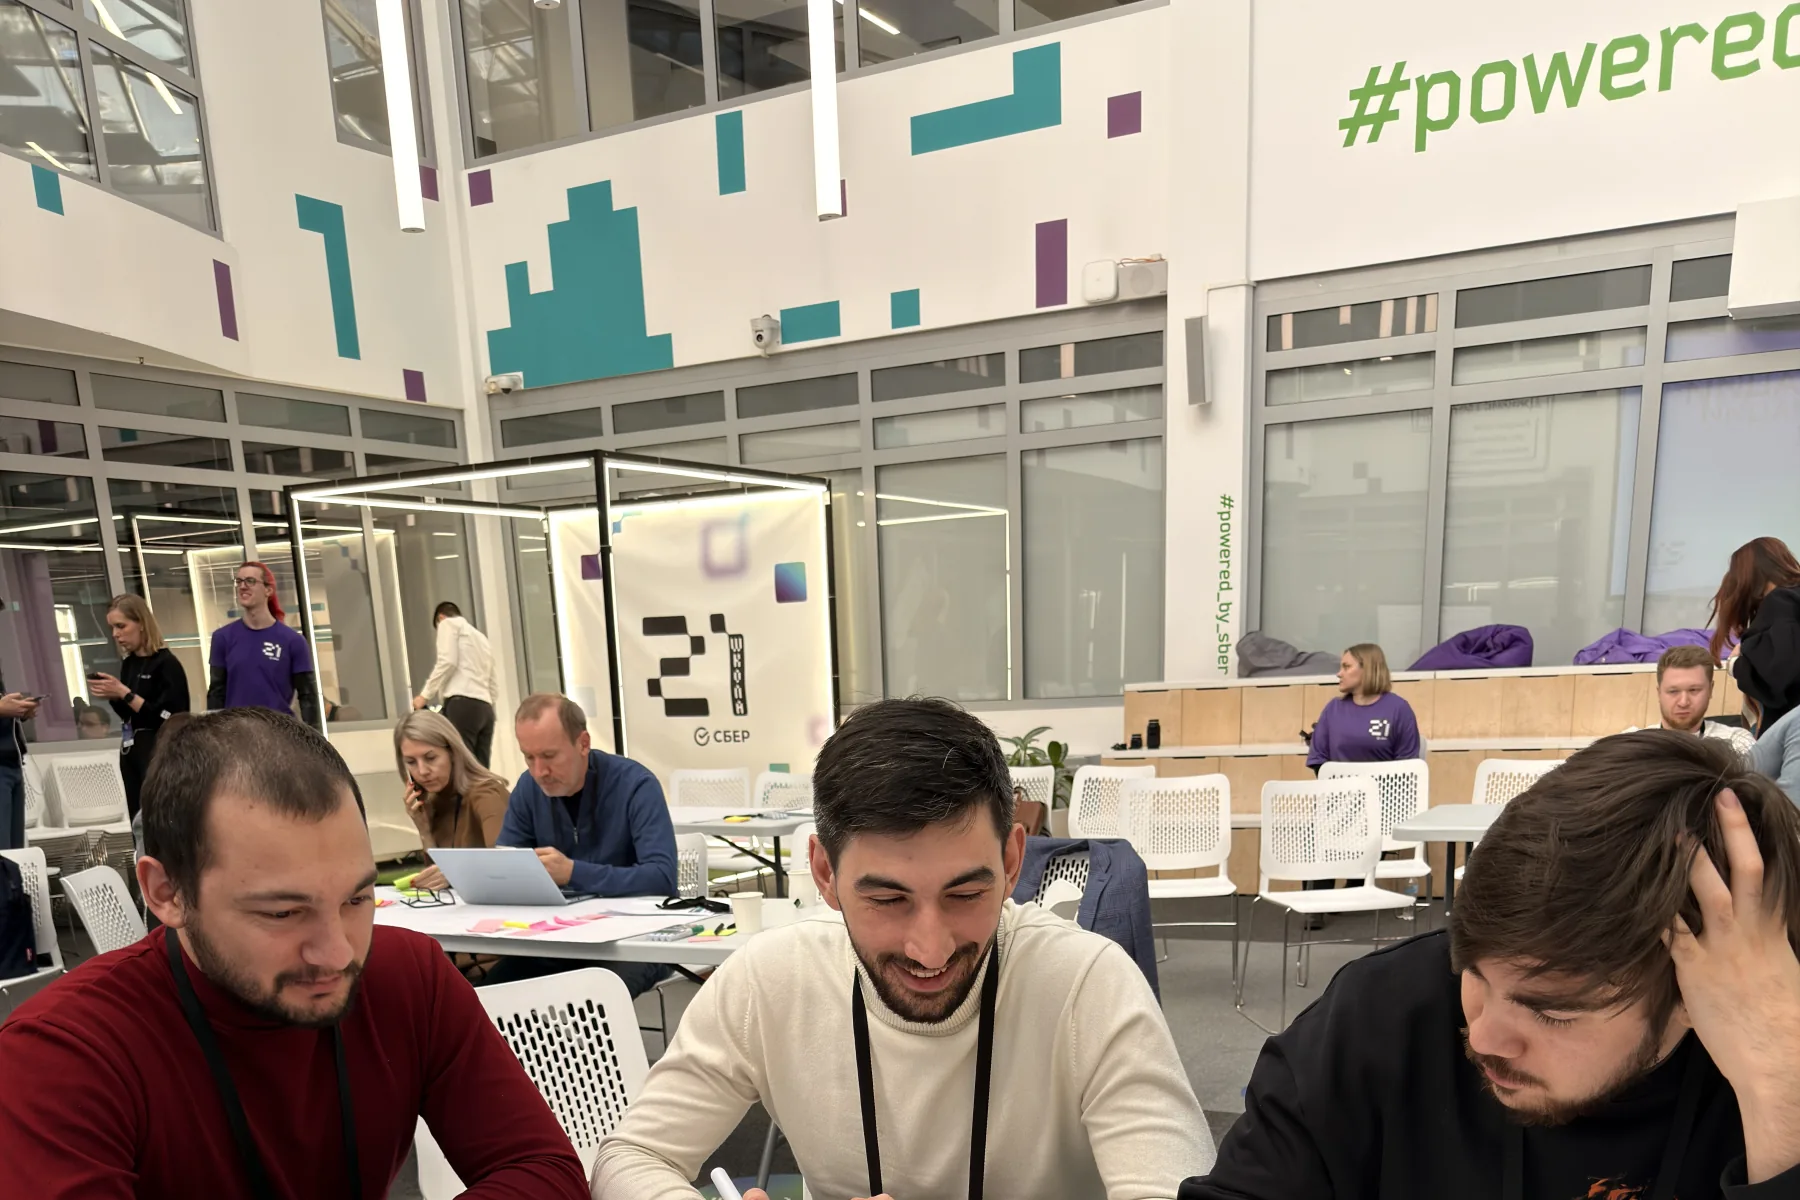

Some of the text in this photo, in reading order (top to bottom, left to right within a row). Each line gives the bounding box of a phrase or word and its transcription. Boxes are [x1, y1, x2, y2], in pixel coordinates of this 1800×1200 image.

[1216, 493, 1235, 675] #powered_by_sber
[730, 636, 745, 715] ШКОЛА
[713, 730, 750, 743] СБЕР
[1369, 719, 1391, 737] 21
